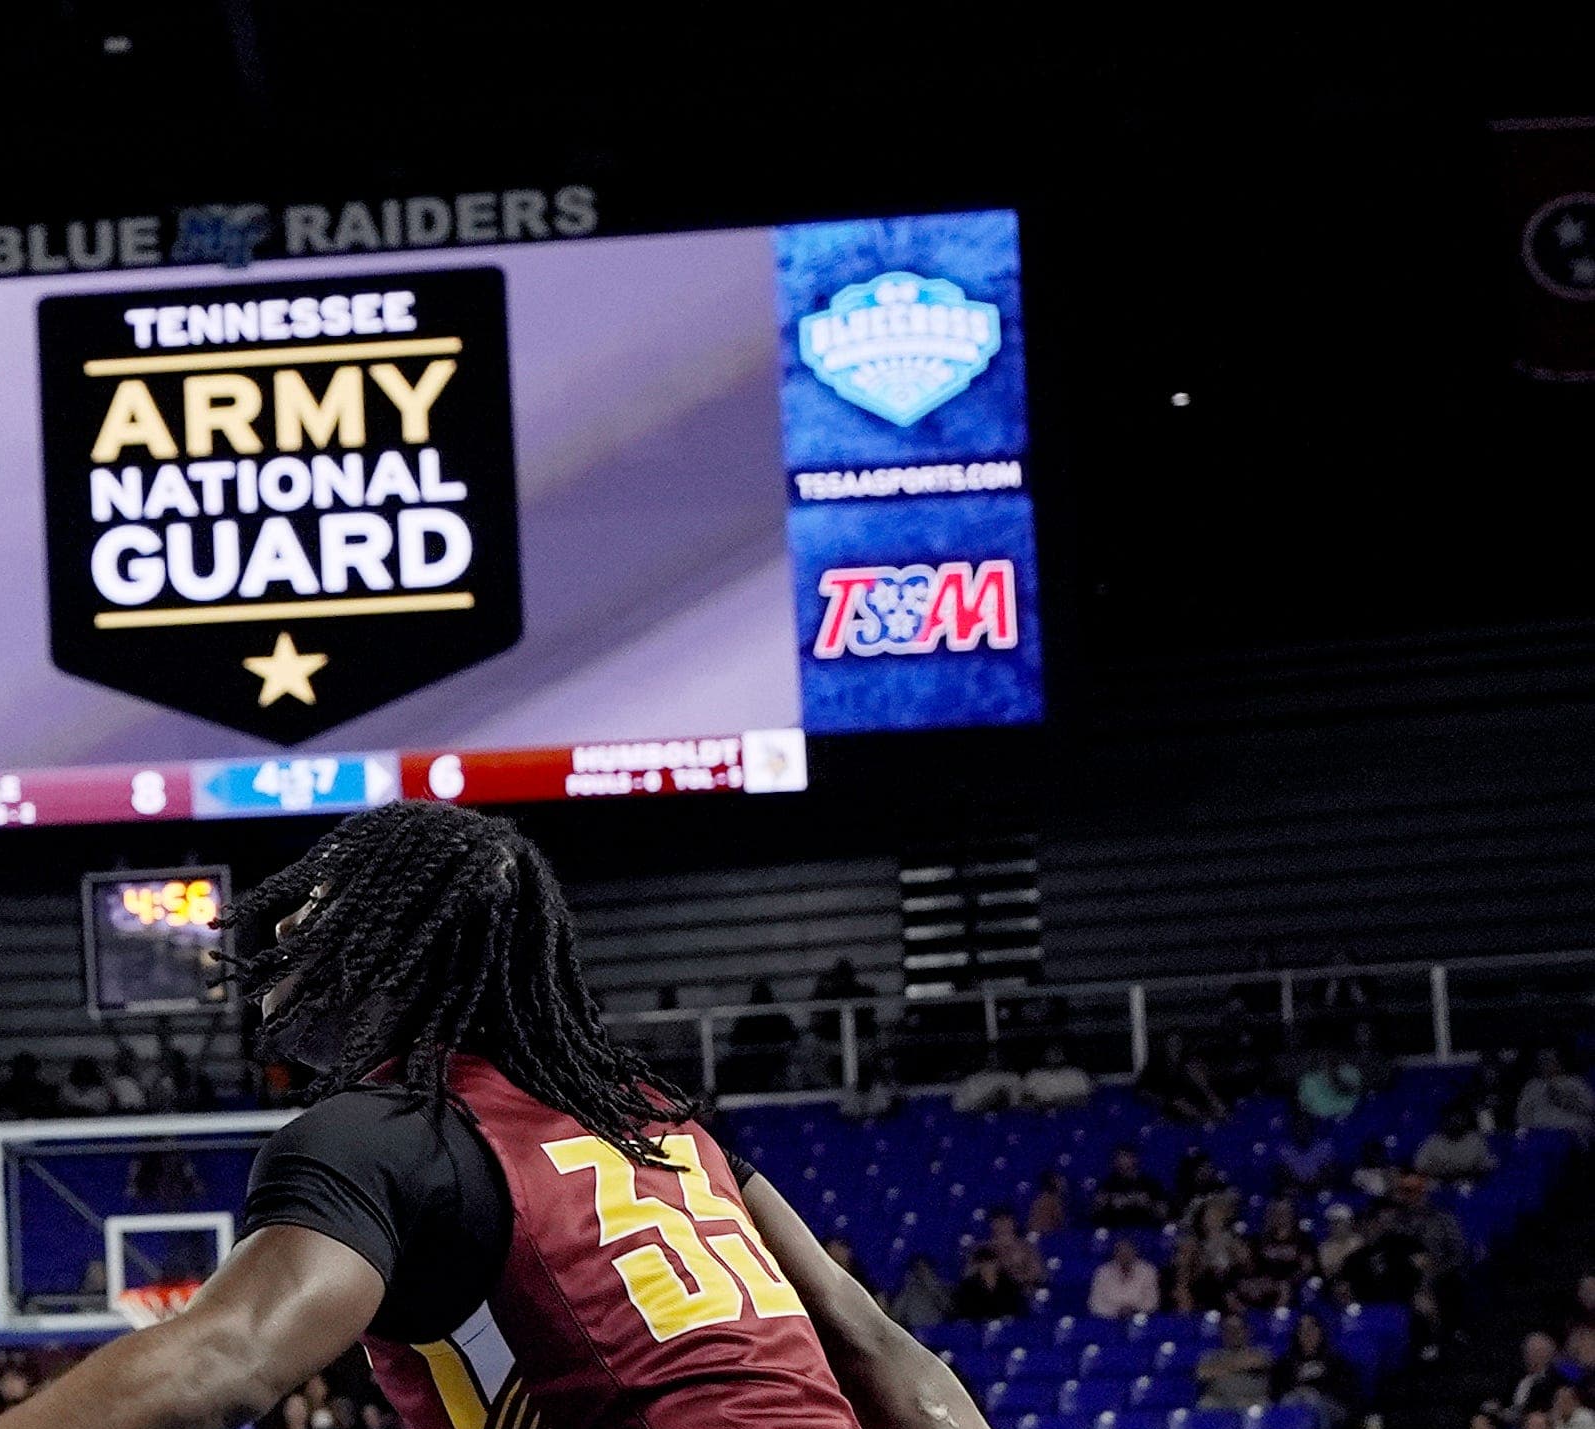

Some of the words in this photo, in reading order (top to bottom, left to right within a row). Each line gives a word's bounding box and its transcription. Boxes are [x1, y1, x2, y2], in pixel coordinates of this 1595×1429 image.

[284, 184, 599, 255] RAIDERS
[124, 290, 418, 349] TENNESSEE
[91, 358, 457, 464] ARMY
[90, 447, 469, 522] NATIONAL
[91, 507, 474, 605] GUARD
[131, 770, 167, 815] 8
[428, 754, 465, 799] 6
